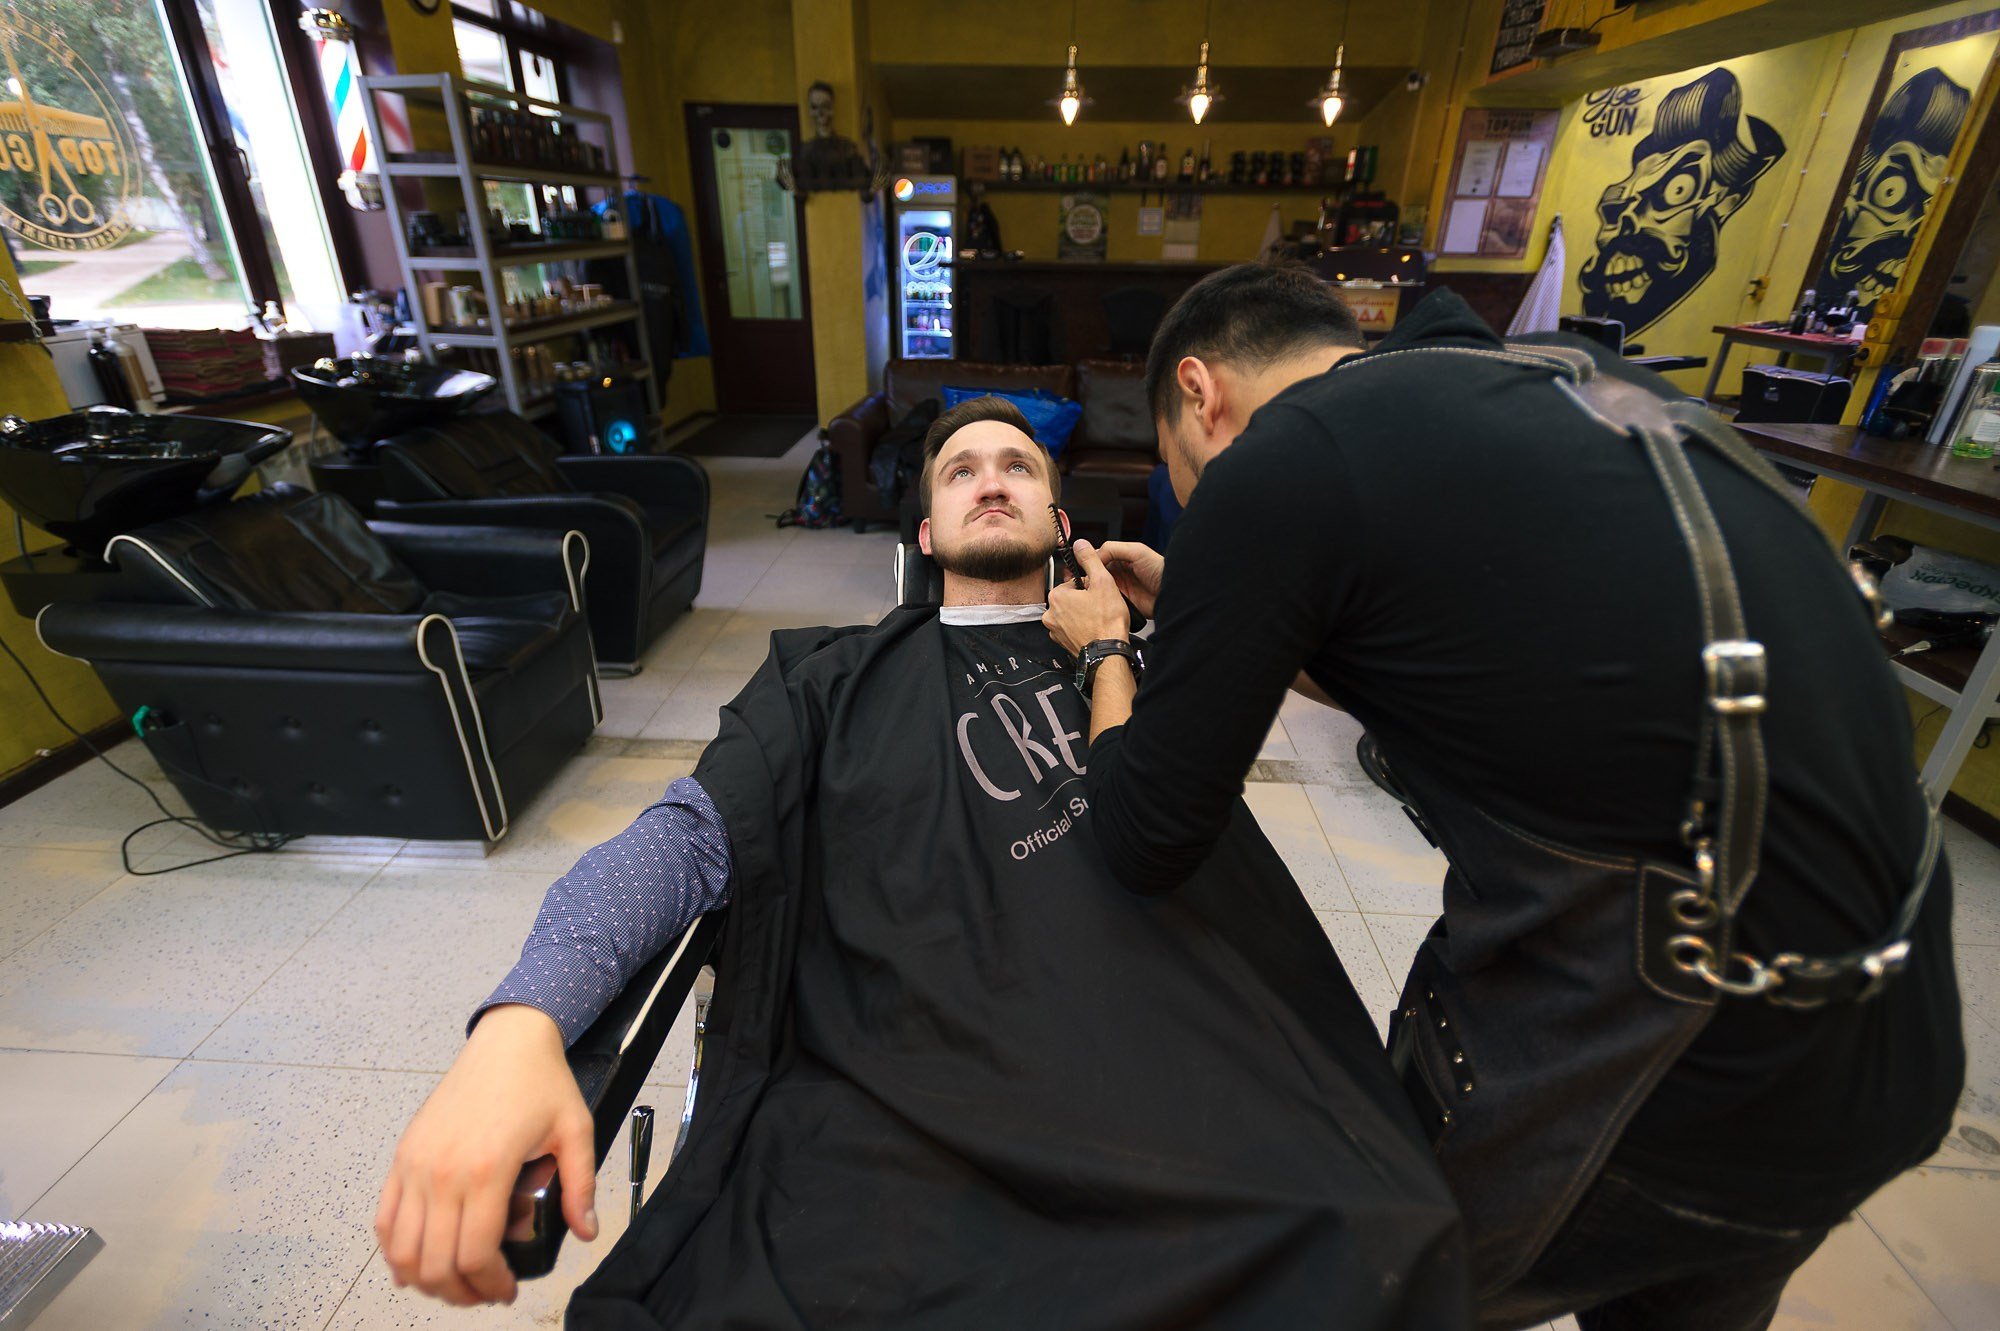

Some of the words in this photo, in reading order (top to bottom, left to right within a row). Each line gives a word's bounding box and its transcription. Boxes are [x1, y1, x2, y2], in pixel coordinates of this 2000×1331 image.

[1591, 107, 1638, 137] GUN
[915, 180, 952, 196] pepsi
[957, 684, 1087, 801] CRE
[1010, 809, 1073, 860] Official
